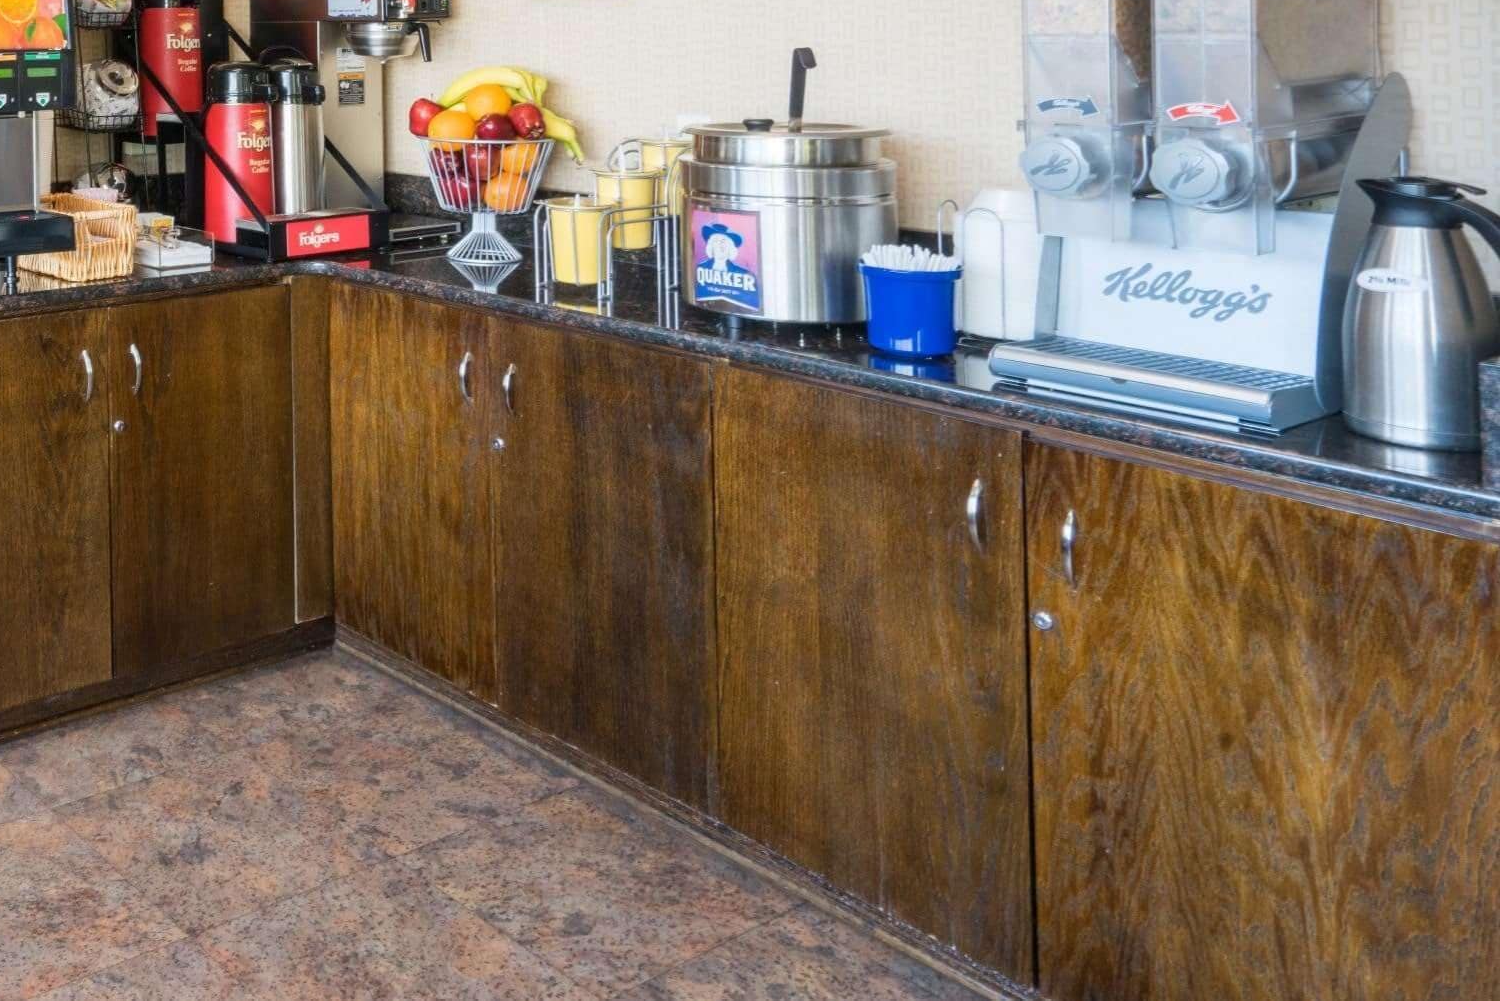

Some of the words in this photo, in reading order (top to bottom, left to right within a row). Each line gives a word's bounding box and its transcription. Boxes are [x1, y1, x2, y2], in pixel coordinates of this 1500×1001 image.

[166, 33, 201, 53] Folger
[298, 231, 340, 248] Folgers
[696, 266, 756, 292] QUAKER
[1102, 262, 1273, 322] Kellogg's
